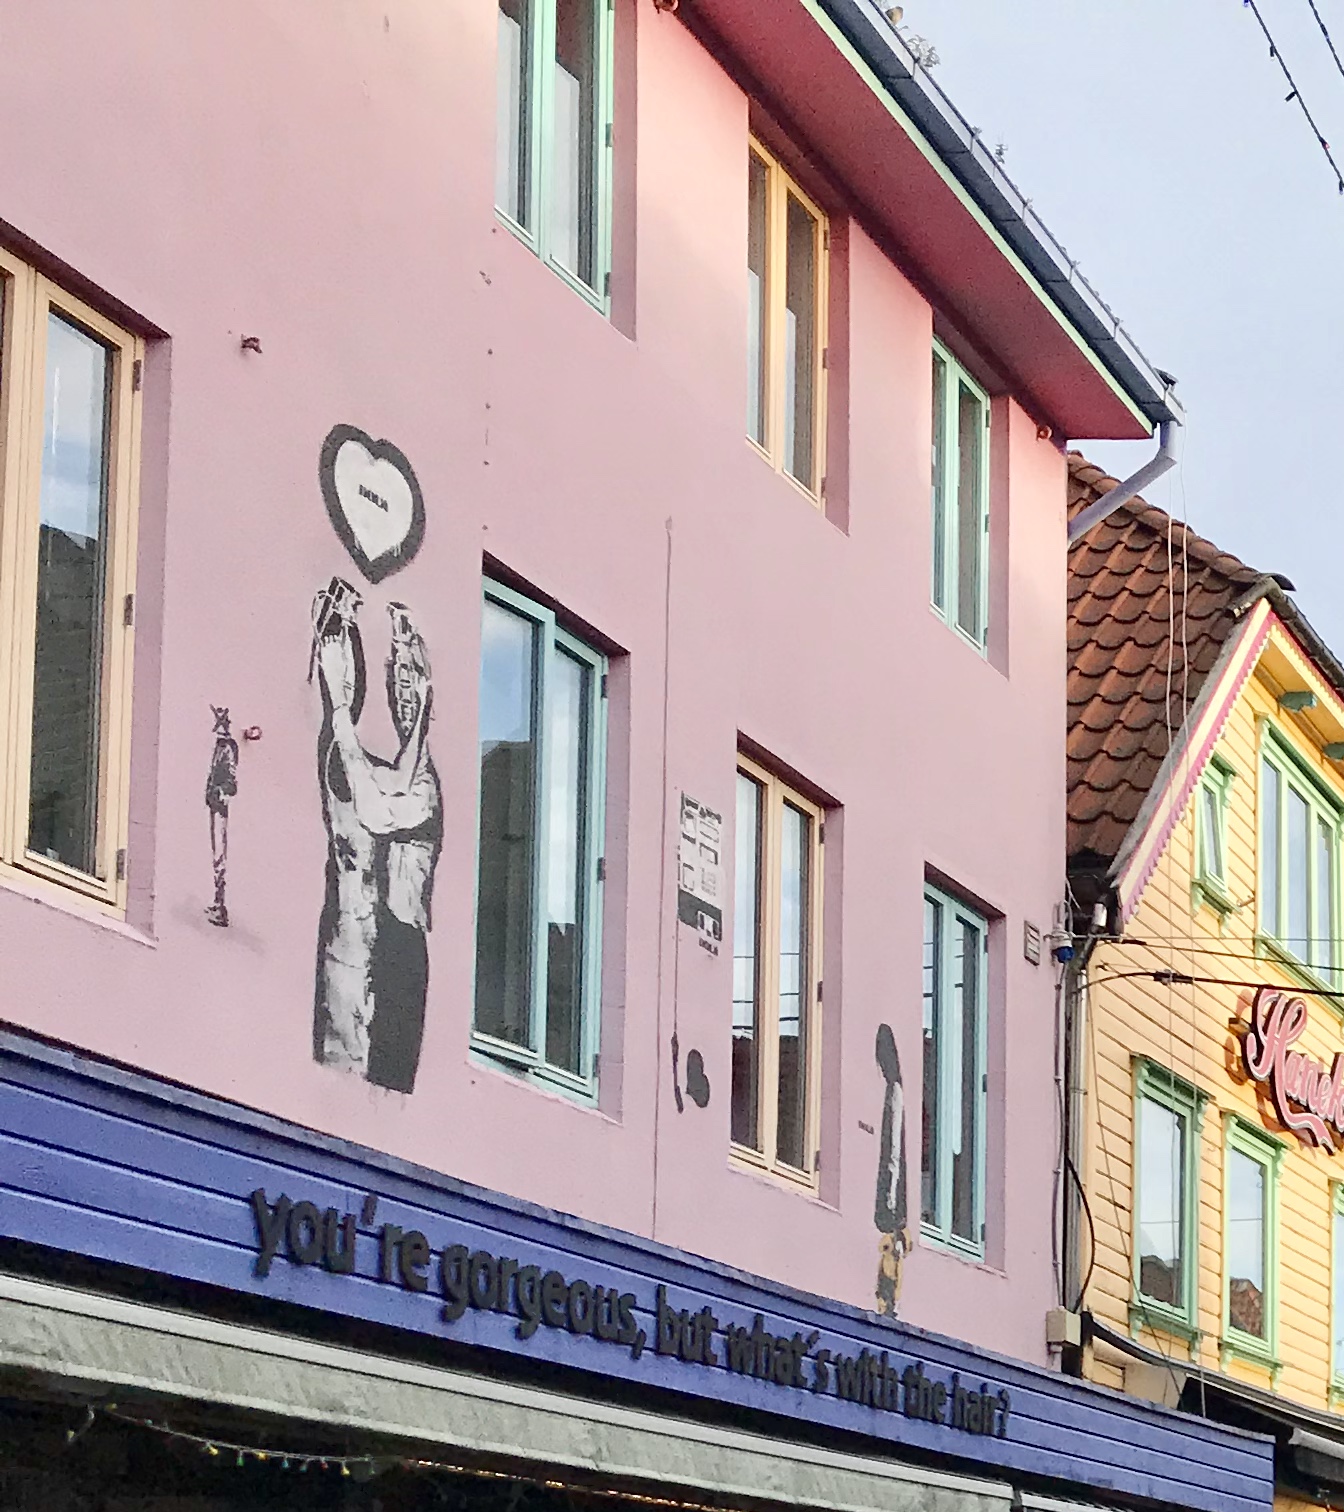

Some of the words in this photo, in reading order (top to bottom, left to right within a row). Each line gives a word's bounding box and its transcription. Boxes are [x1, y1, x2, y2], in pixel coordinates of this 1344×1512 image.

[252, 1187, 431, 1292] you're
[440, 1244, 647, 1360] gorgeous,
[655, 1283, 719, 1366] but
[834, 1348, 899, 1411] with
[901, 1360, 945, 1424] the
[951, 1371, 1011, 1438] hair?
